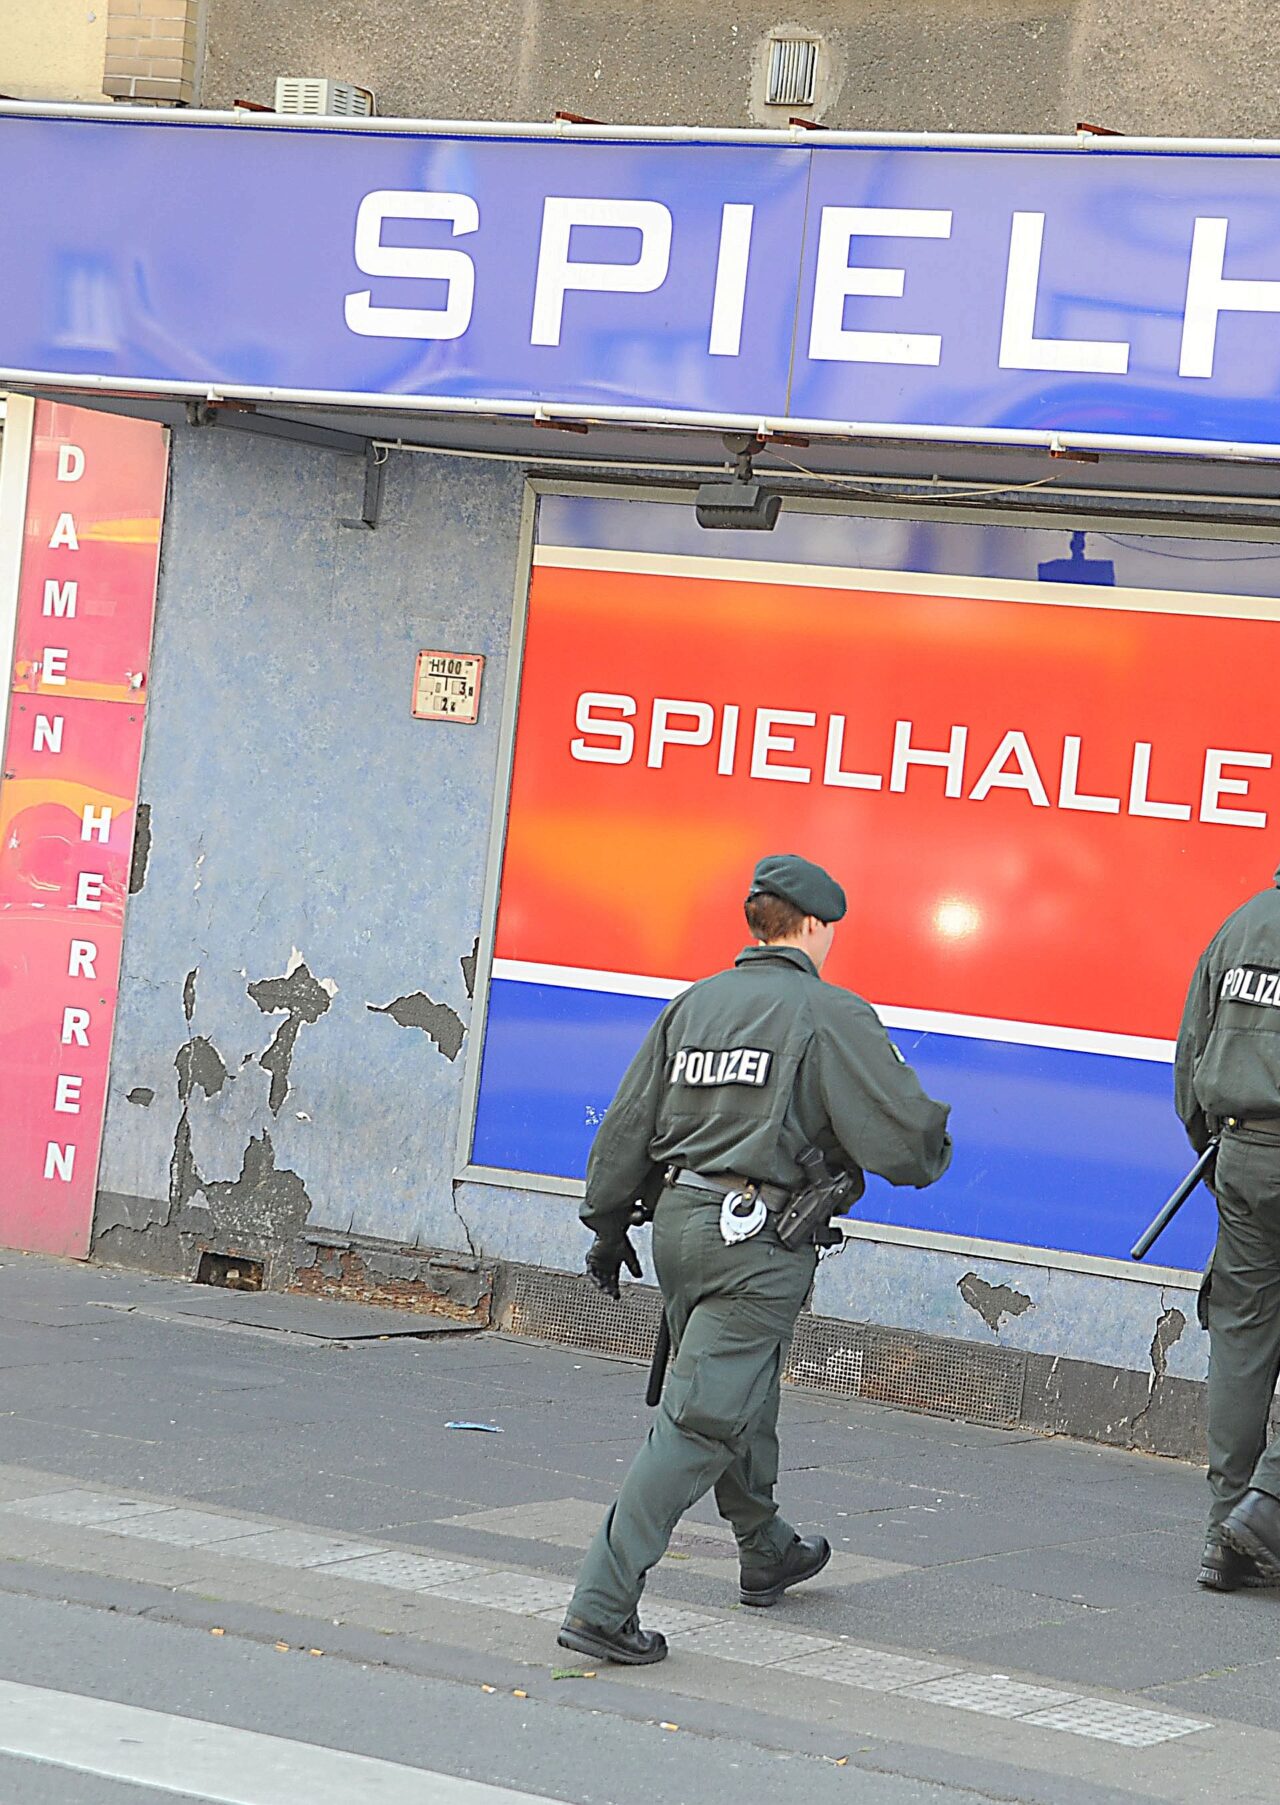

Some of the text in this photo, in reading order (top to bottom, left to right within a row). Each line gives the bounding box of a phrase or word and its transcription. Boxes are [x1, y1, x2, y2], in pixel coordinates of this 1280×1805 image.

[33, 444, 86, 754] DAMEN
[431, 658, 463, 676] H100
[570, 691, 1273, 829] SPIELHALLE
[43, 804, 113, 1183] HERREN
[670, 1049, 770, 1085] POLIZEI
